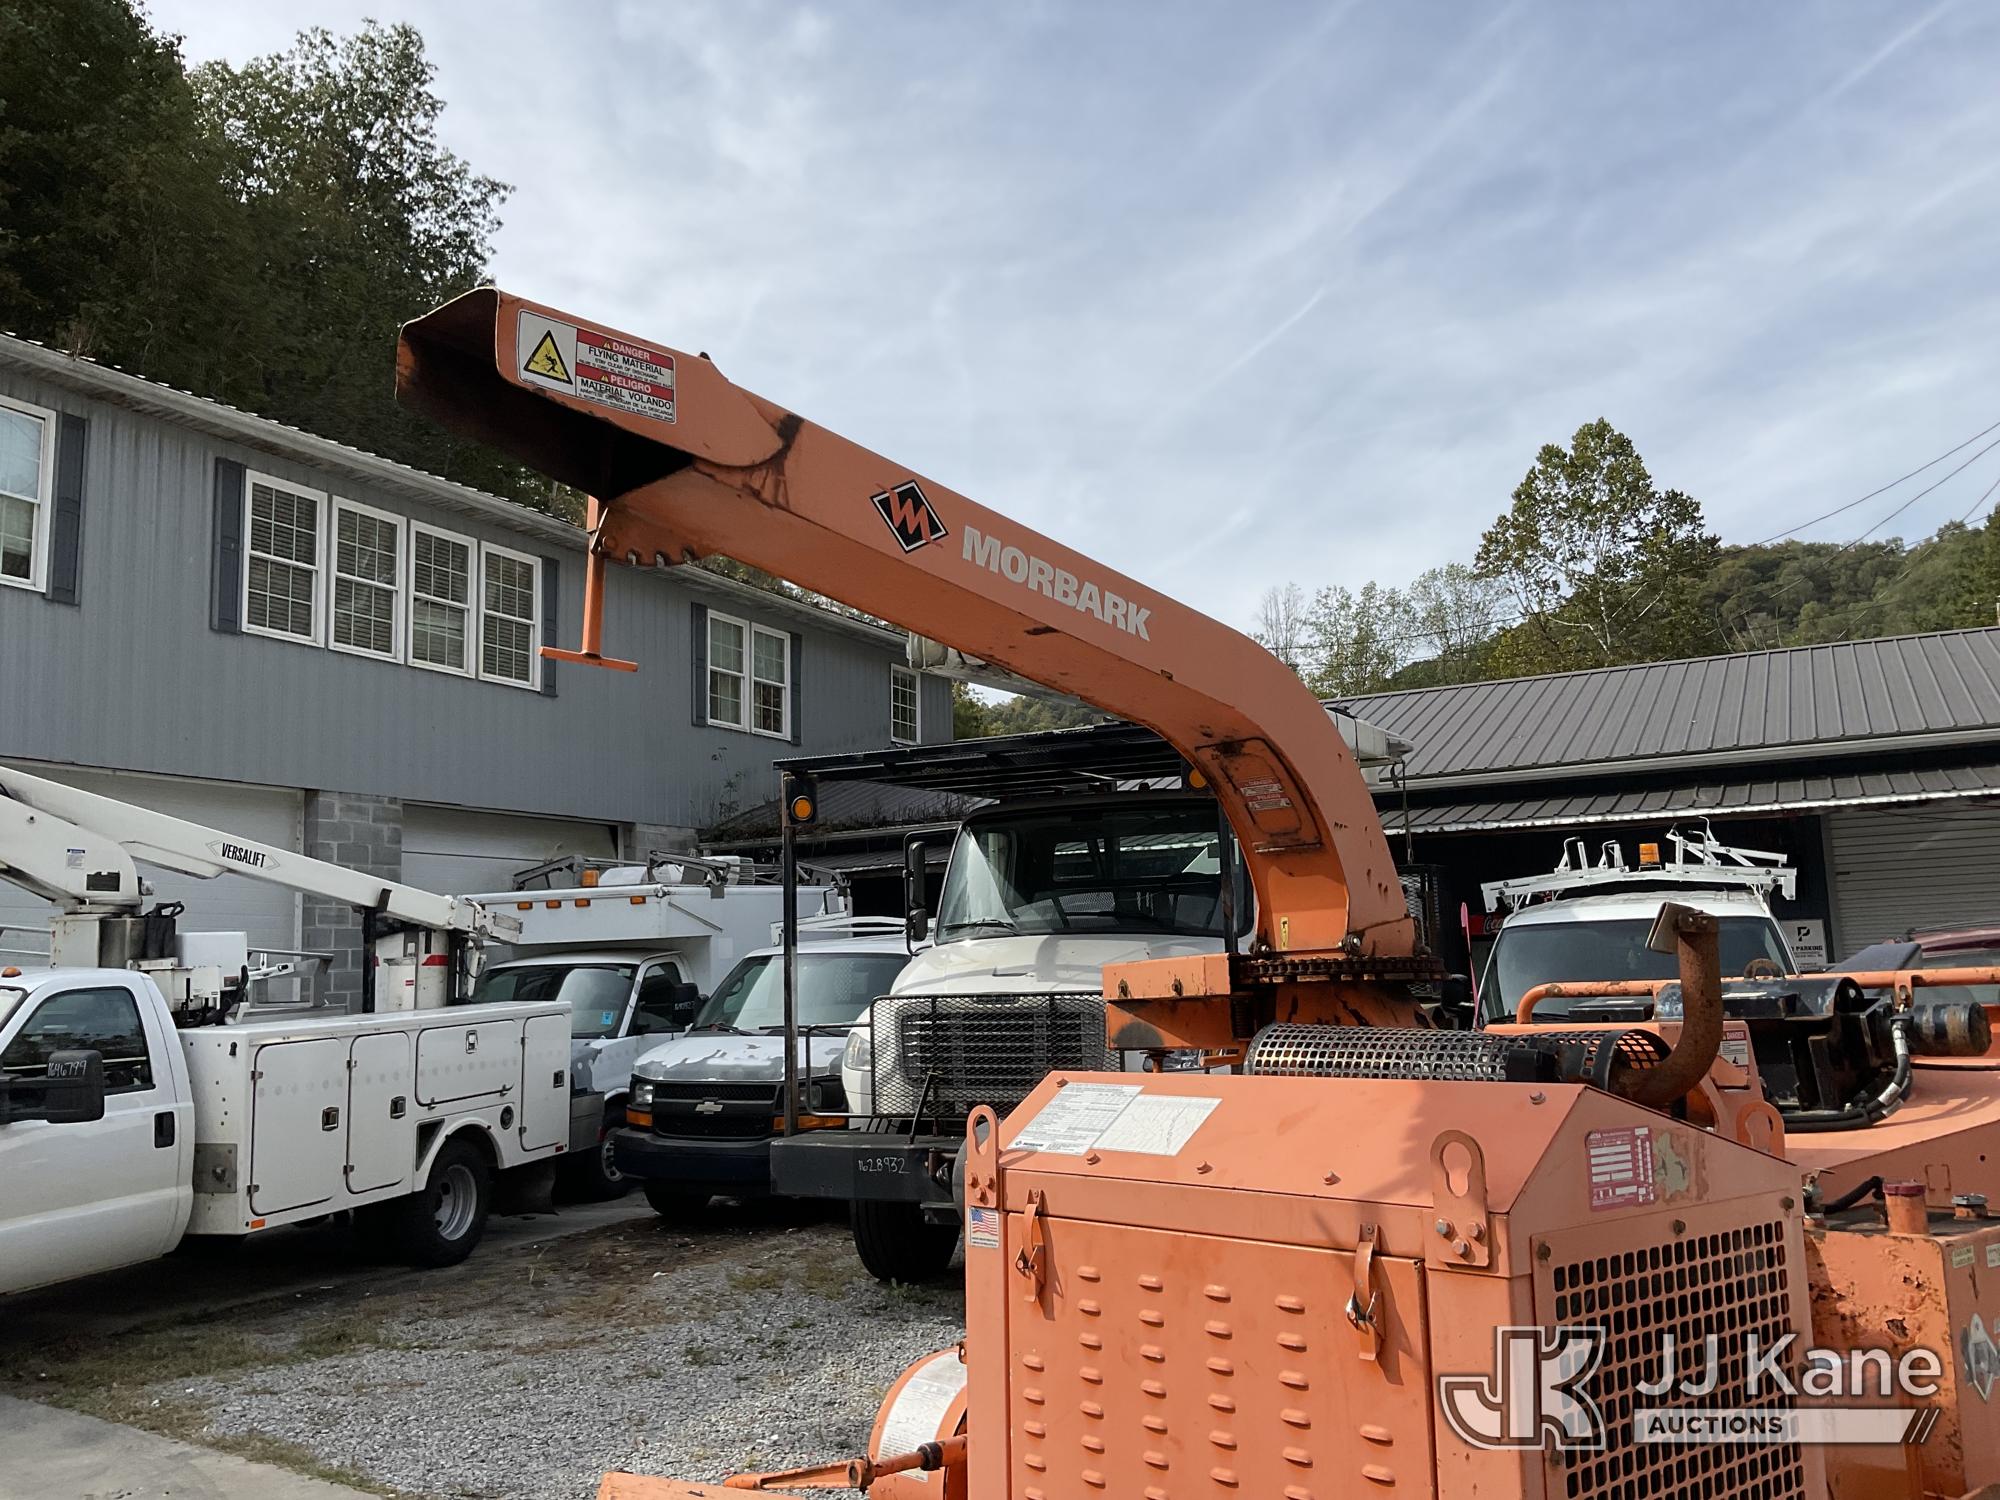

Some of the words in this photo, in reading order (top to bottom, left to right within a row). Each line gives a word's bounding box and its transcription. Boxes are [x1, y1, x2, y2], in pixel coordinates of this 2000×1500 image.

[588, 346, 619, 363] FLYING
[622, 356, 665, 377] MATERIAL
[612, 341, 650, 360] DANGER
[580, 378, 626, 398] MATERIAL
[628, 392, 671, 410] VOLANDO
[610, 375, 652, 394] PELIGRO
[962, 526, 1151, 642] MORBARK
[221, 842, 267, 868] VERSALIFT
